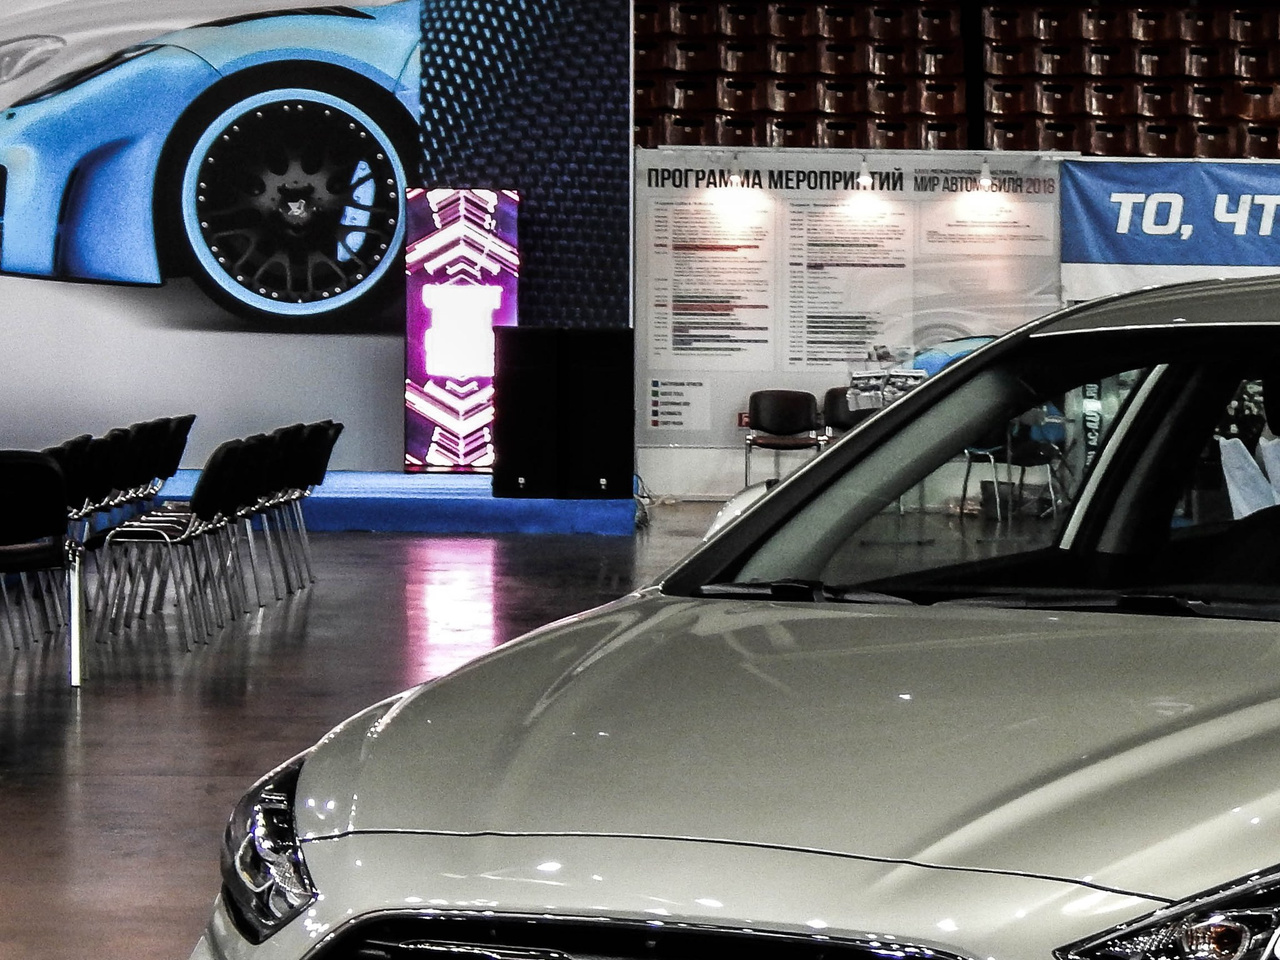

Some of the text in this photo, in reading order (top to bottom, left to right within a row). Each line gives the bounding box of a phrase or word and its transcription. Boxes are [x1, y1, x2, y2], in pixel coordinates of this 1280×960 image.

[768, 167, 904, 191] МЕРОПРИТИЙ
[913, 176, 940, 192] МИР
[1110, 193, 1193, 240] ТО,
